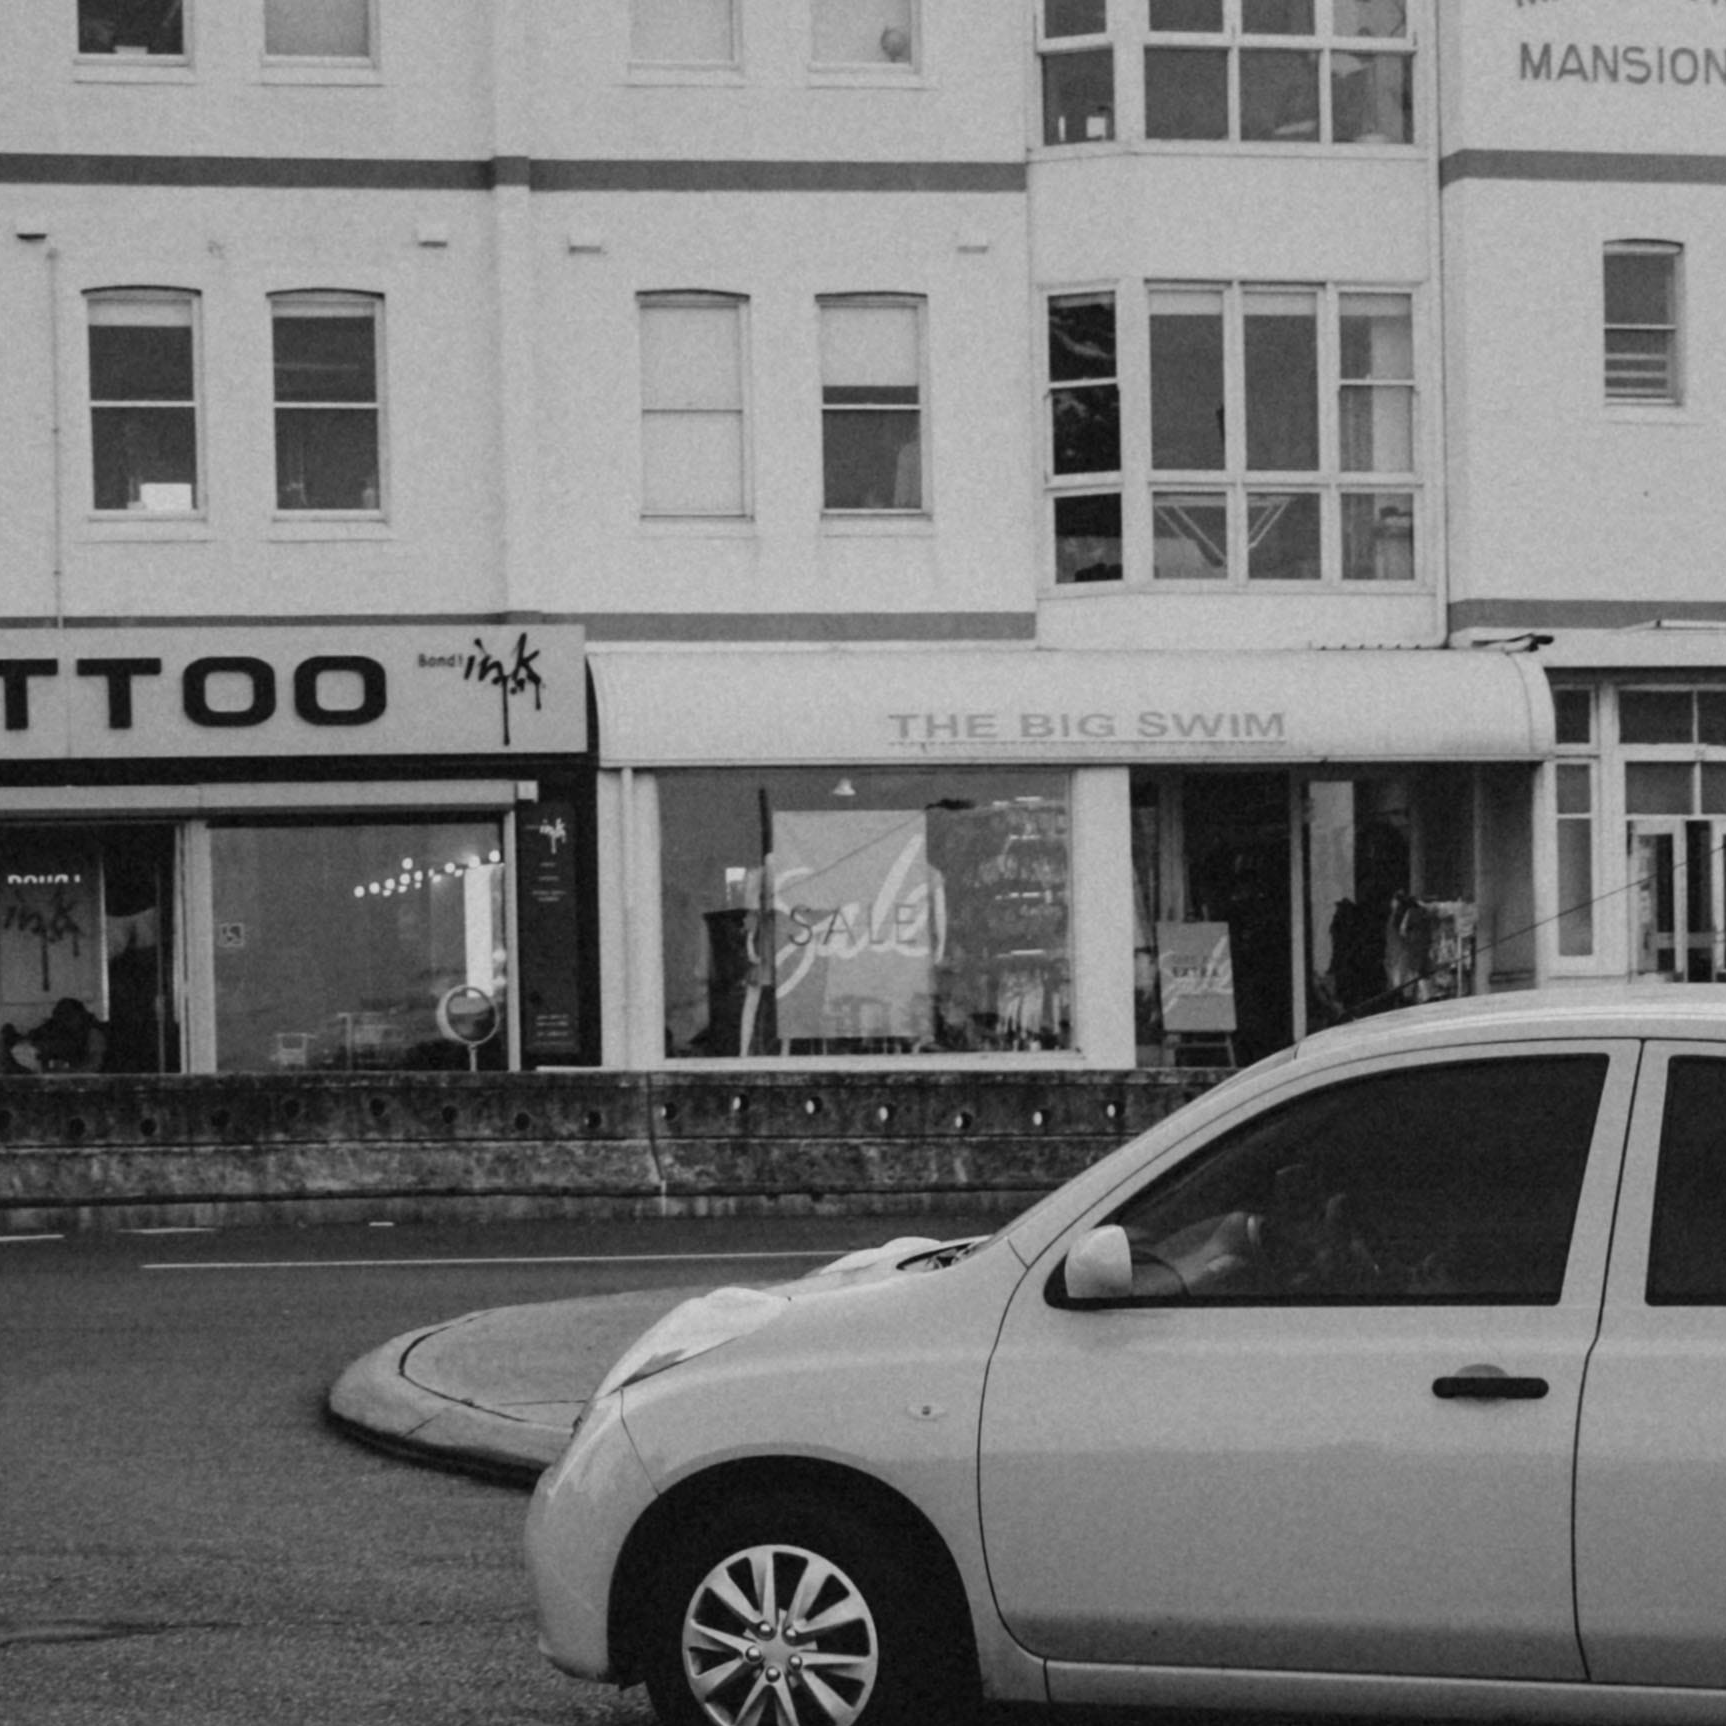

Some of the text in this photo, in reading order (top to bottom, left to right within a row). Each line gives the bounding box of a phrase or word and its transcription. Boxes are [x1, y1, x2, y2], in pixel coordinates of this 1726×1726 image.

[418, 631, 542, 746] Bondi ink
[888, 711, 1286, 739] THE BIG SWIM
[788, 902, 918, 947] SALE
